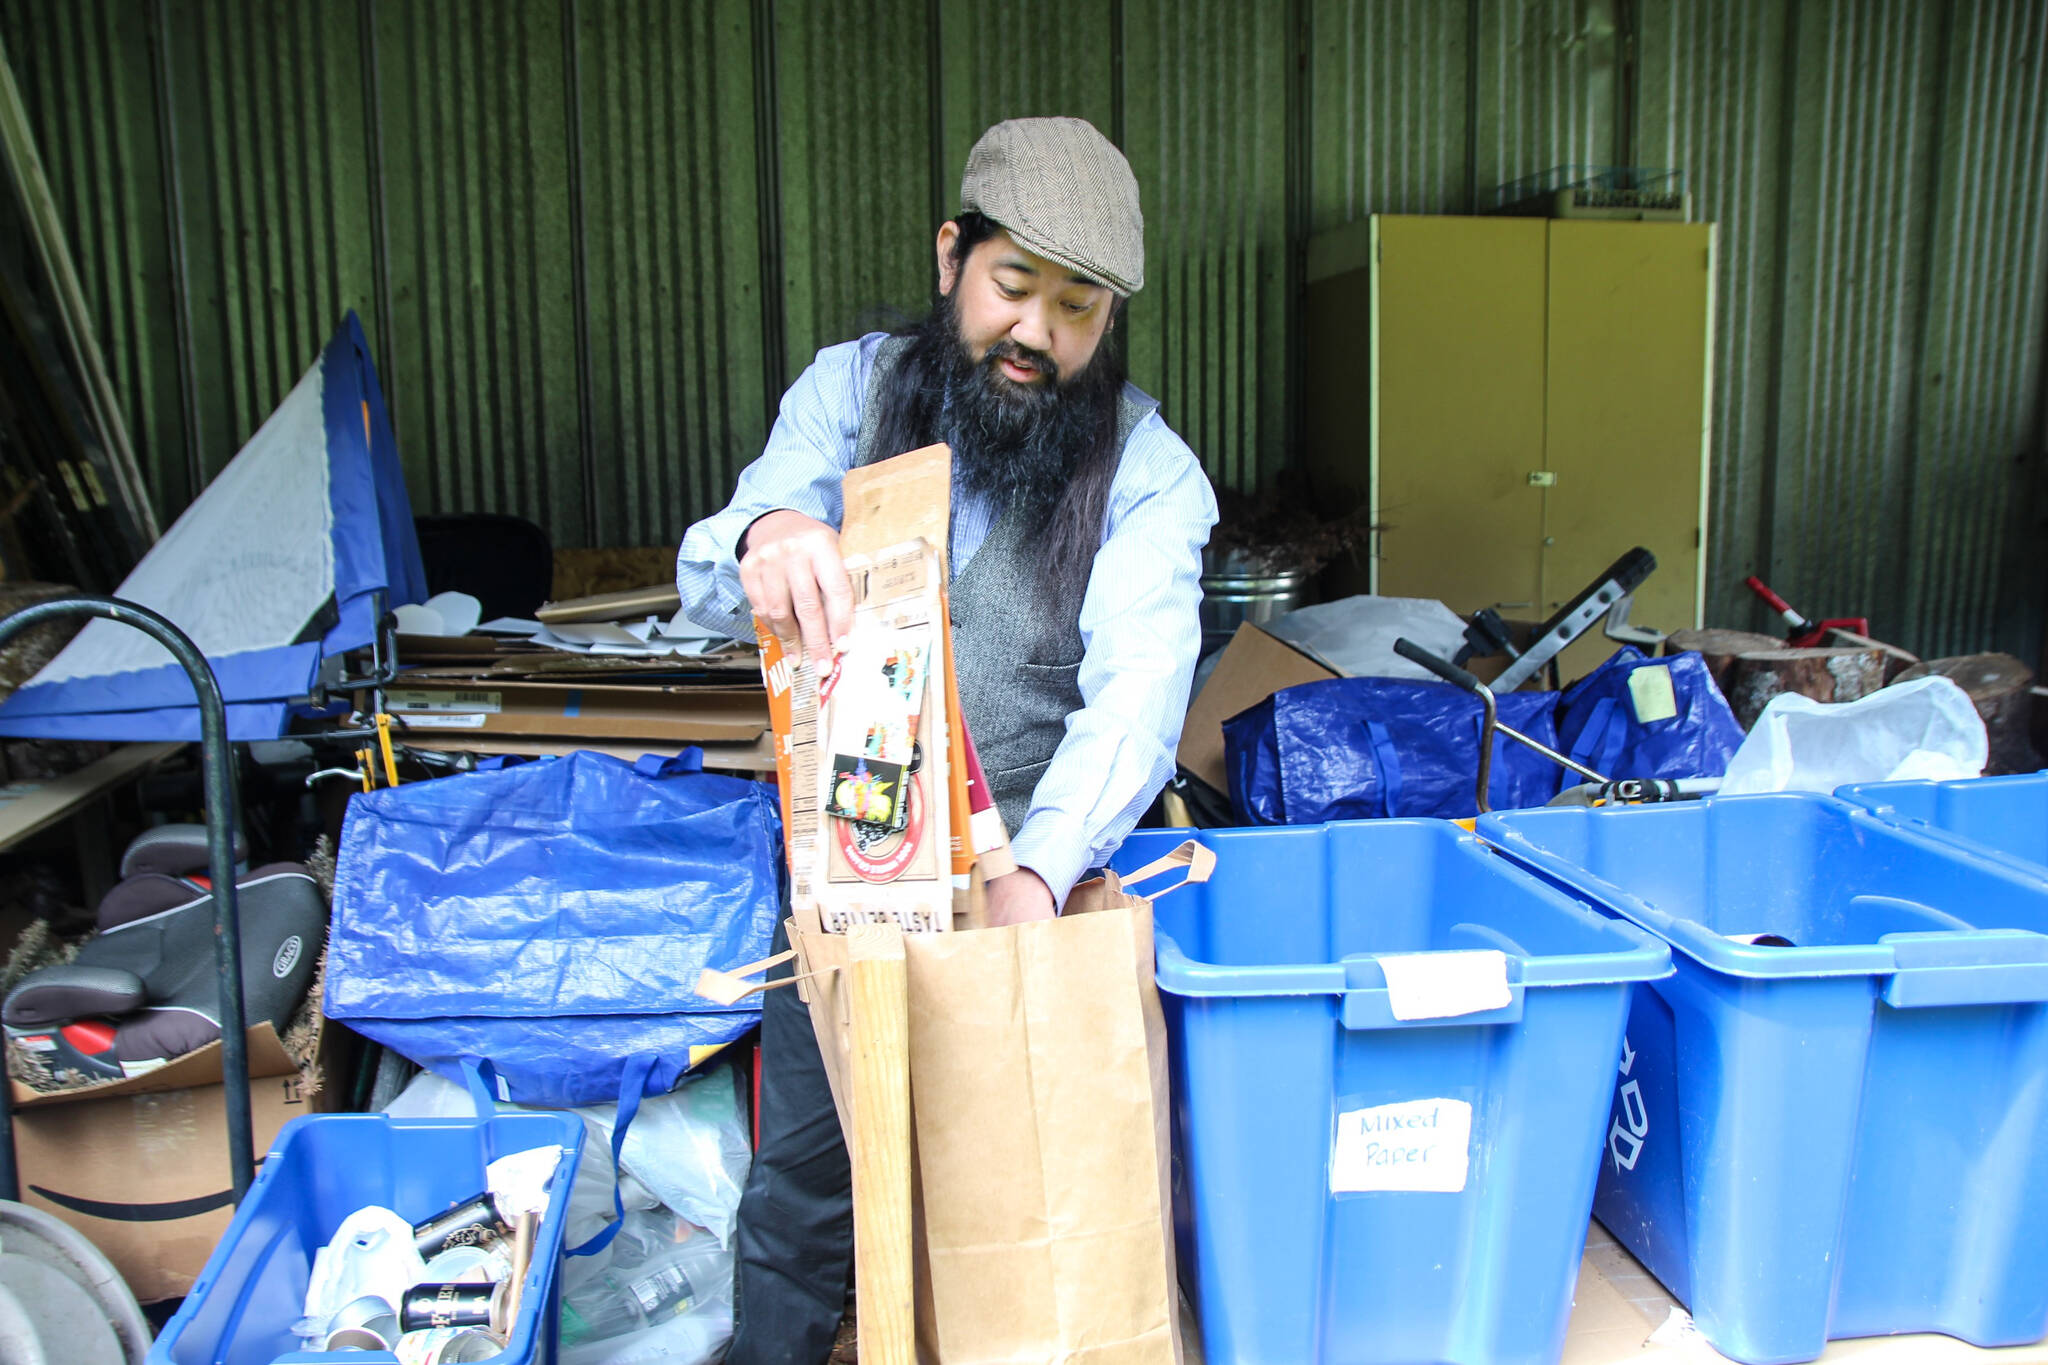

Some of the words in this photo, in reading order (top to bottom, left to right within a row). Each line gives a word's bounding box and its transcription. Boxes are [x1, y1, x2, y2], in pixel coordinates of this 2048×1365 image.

[891, 911, 943, 933] TASTE
[276, 938, 298, 972] GRACO
[1366, 1142, 1438, 1167] Paper
